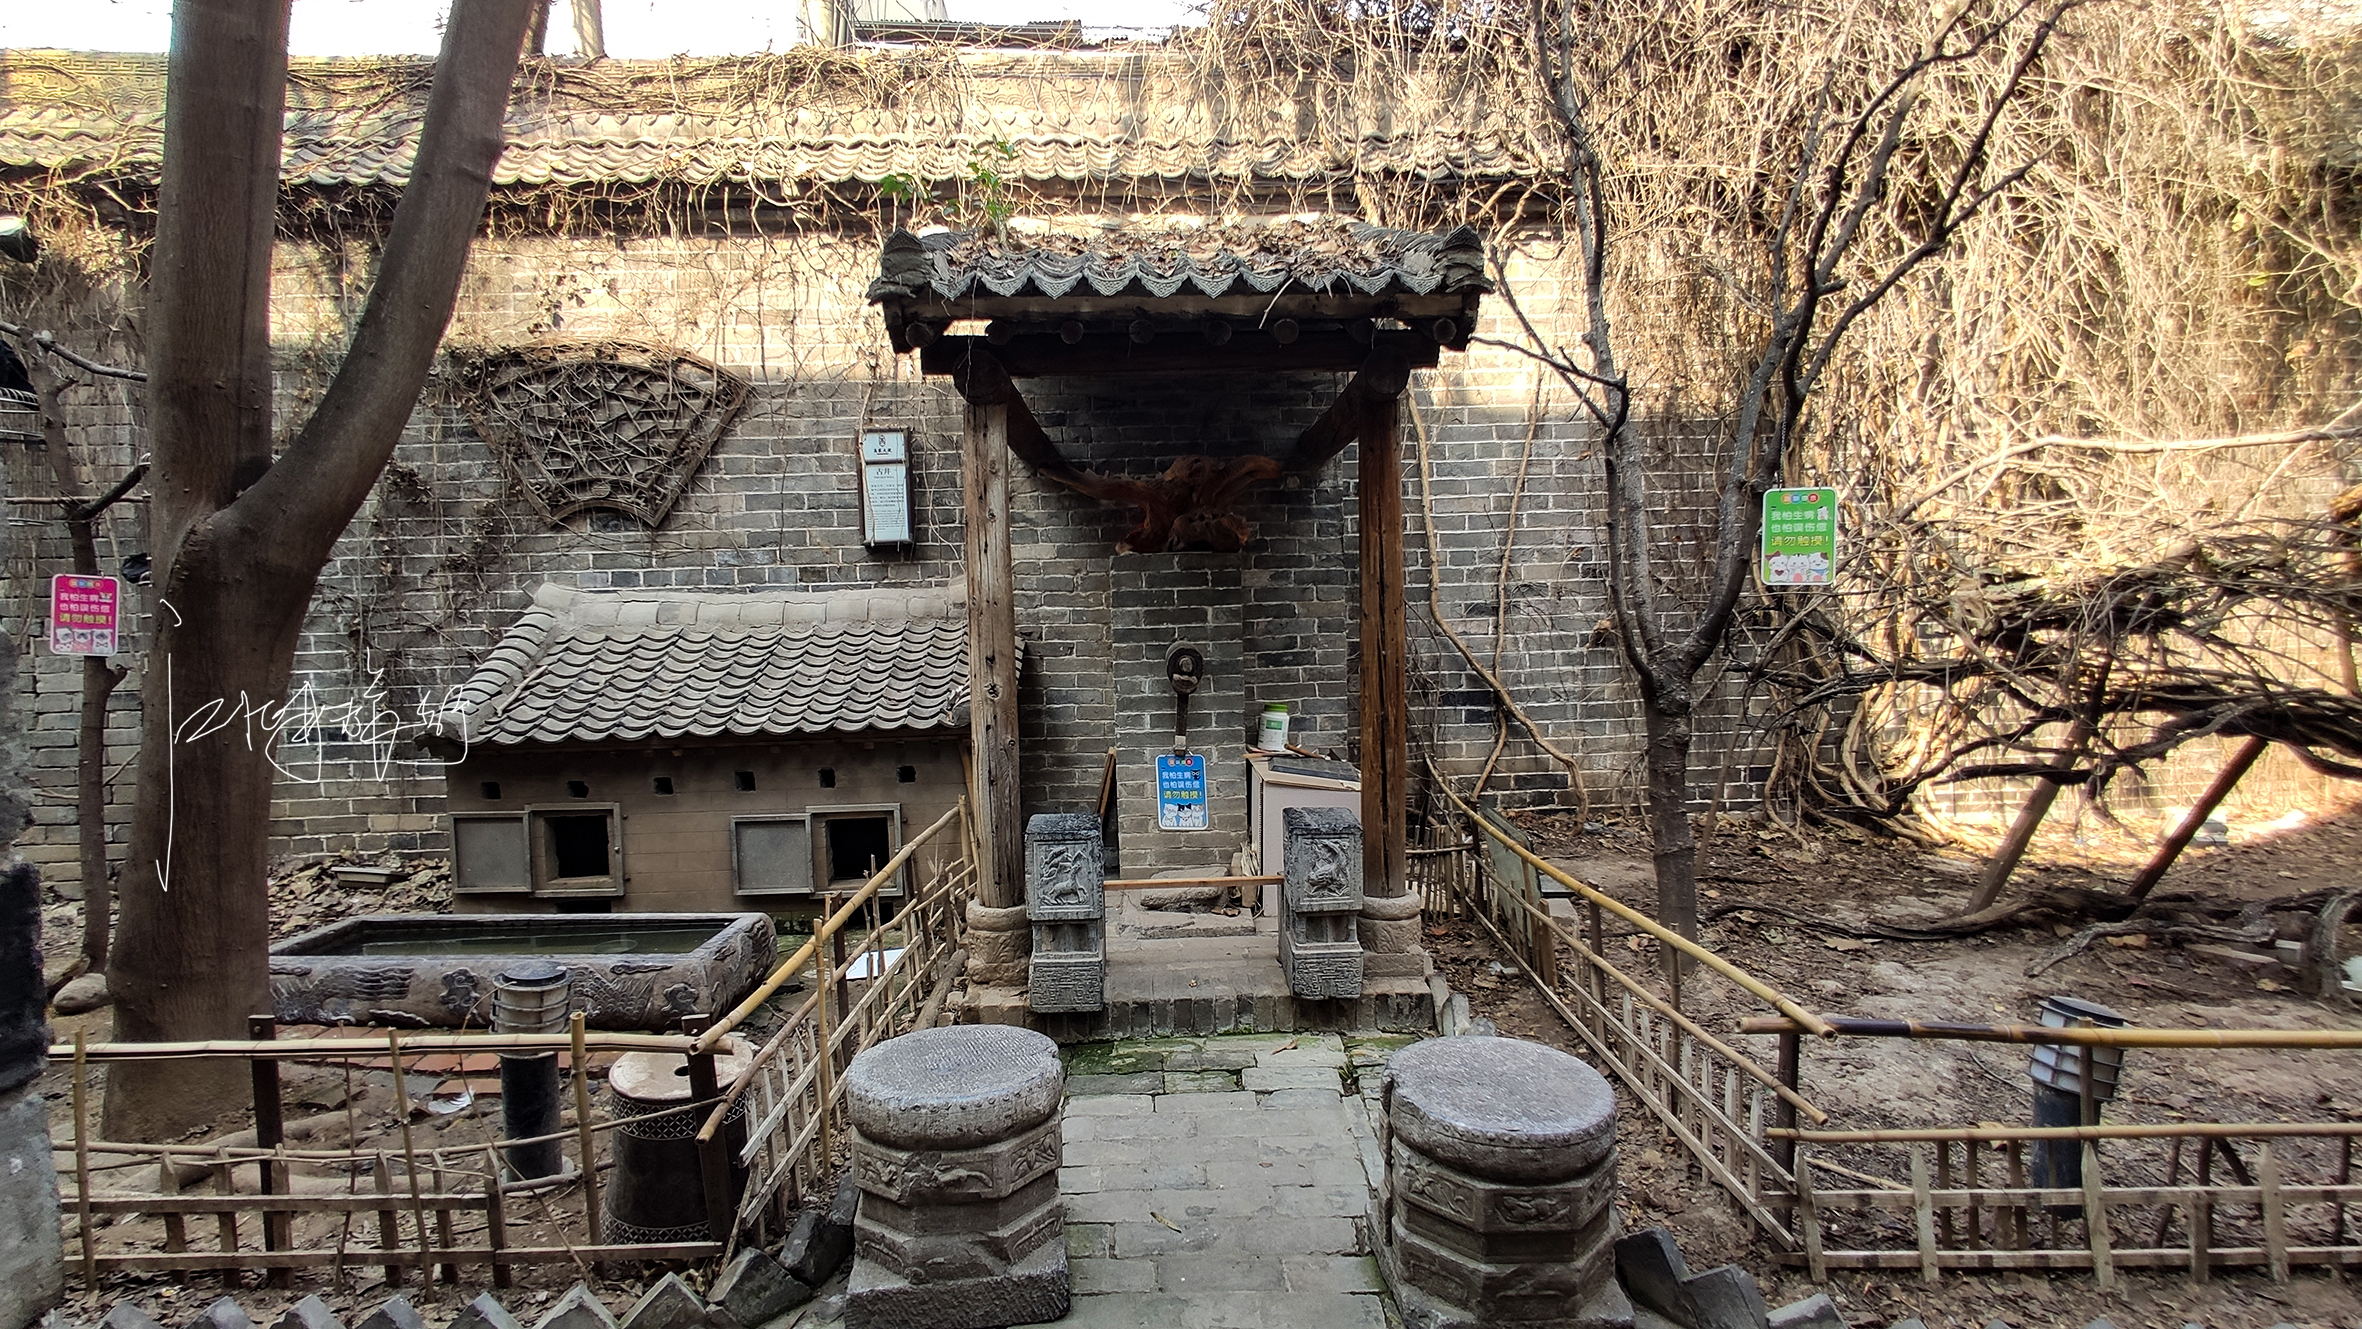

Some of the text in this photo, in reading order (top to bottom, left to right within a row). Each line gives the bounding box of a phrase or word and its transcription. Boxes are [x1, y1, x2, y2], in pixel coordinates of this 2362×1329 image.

[876, 467, 891, 476] 古井
[1771, 510, 1815, 521] 我怕生病
[1771, 522, 1827, 533] 也怕误伤您
[59, 592, 99, 603] 我怕生病
[59, 603, 110, 613] 也怕误伤您
[1162, 771, 1191, 780] 我怕生病
[1162, 780, 1200, 789] 也怕误伤您
